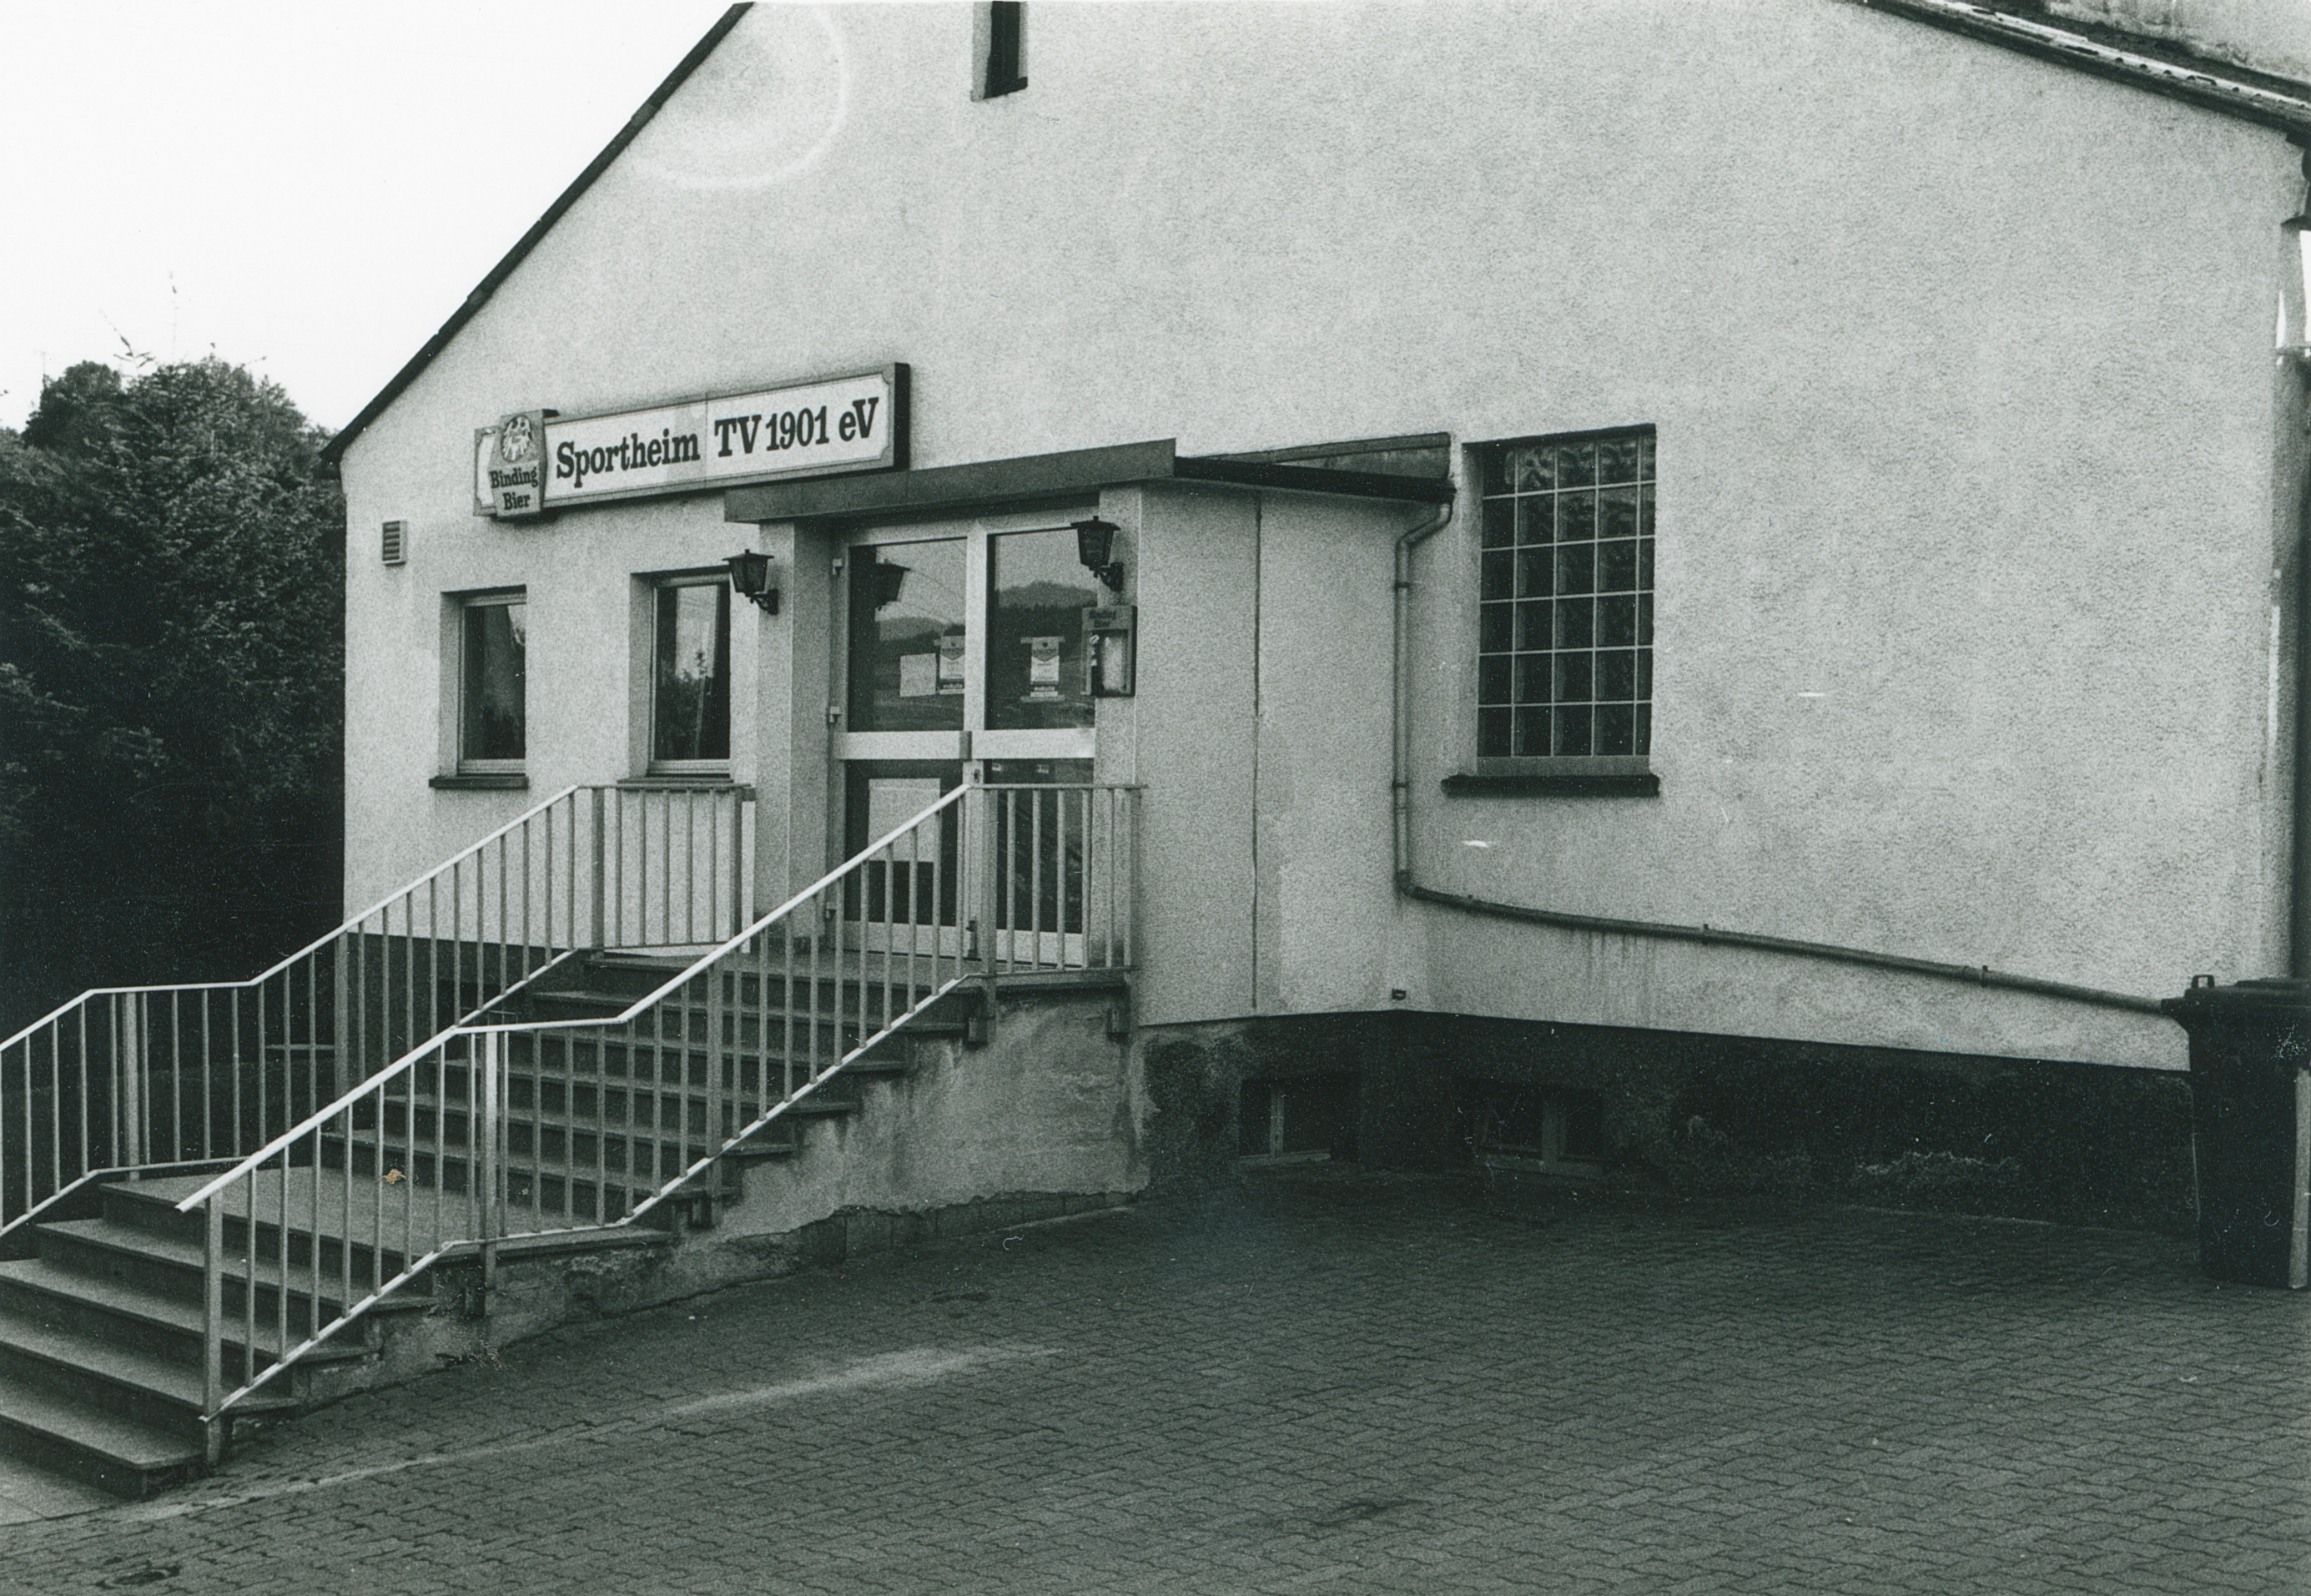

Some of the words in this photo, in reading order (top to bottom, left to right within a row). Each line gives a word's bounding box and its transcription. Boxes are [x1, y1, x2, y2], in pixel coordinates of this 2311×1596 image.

[556, 428, 701, 488] Sportheim
[715, 414, 762, 457] TV
[766, 406, 830, 451] 1901
[839, 397, 879, 442] eV
[489, 466, 539, 490] Binding
[503, 492, 531, 511] Bier
